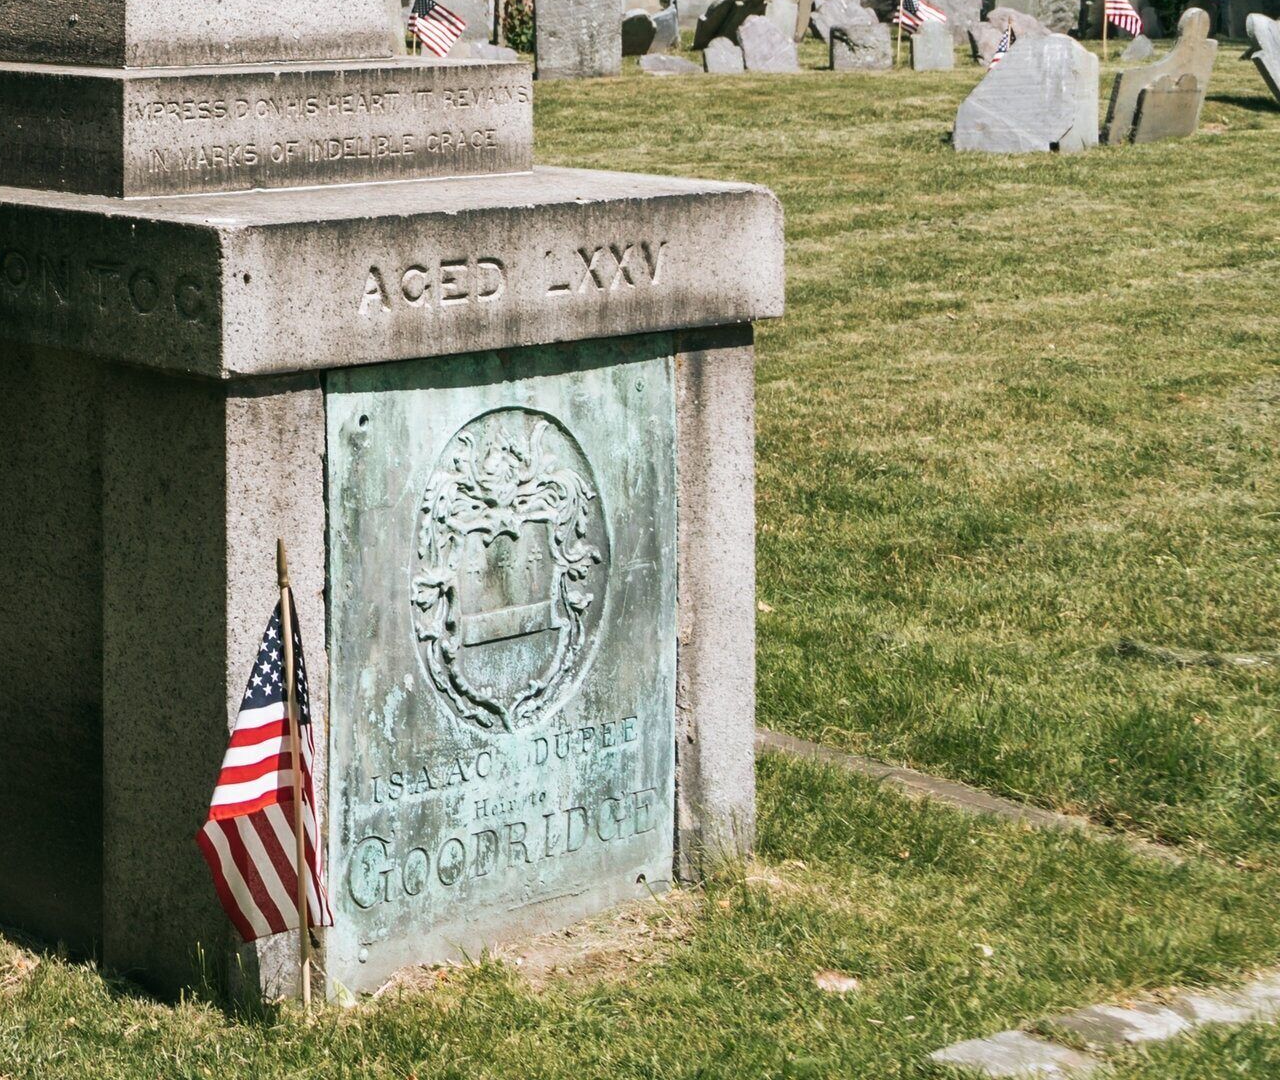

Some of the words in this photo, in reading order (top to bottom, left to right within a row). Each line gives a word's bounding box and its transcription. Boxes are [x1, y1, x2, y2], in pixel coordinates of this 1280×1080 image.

[326, 91, 400, 116] HEART
[411, 88, 433, 111] IT
[149, 146, 170, 172] IN
[180, 142, 259, 170] MARKS
[271, 140, 299, 163] OF
[309, 133, 415, 163] INDELIBLE
[426, 128, 497, 154] GRACE
[358, 256, 507, 316] AGED
[543, 240, 668, 296] LXXV
[371, 751, 494, 804] ISAAC
[531, 716, 639, 766] DUPEE
[474, 797, 518, 820] Heir
[525, 791, 548, 811] to
[346, 786, 659, 909] GOODRIDGE
